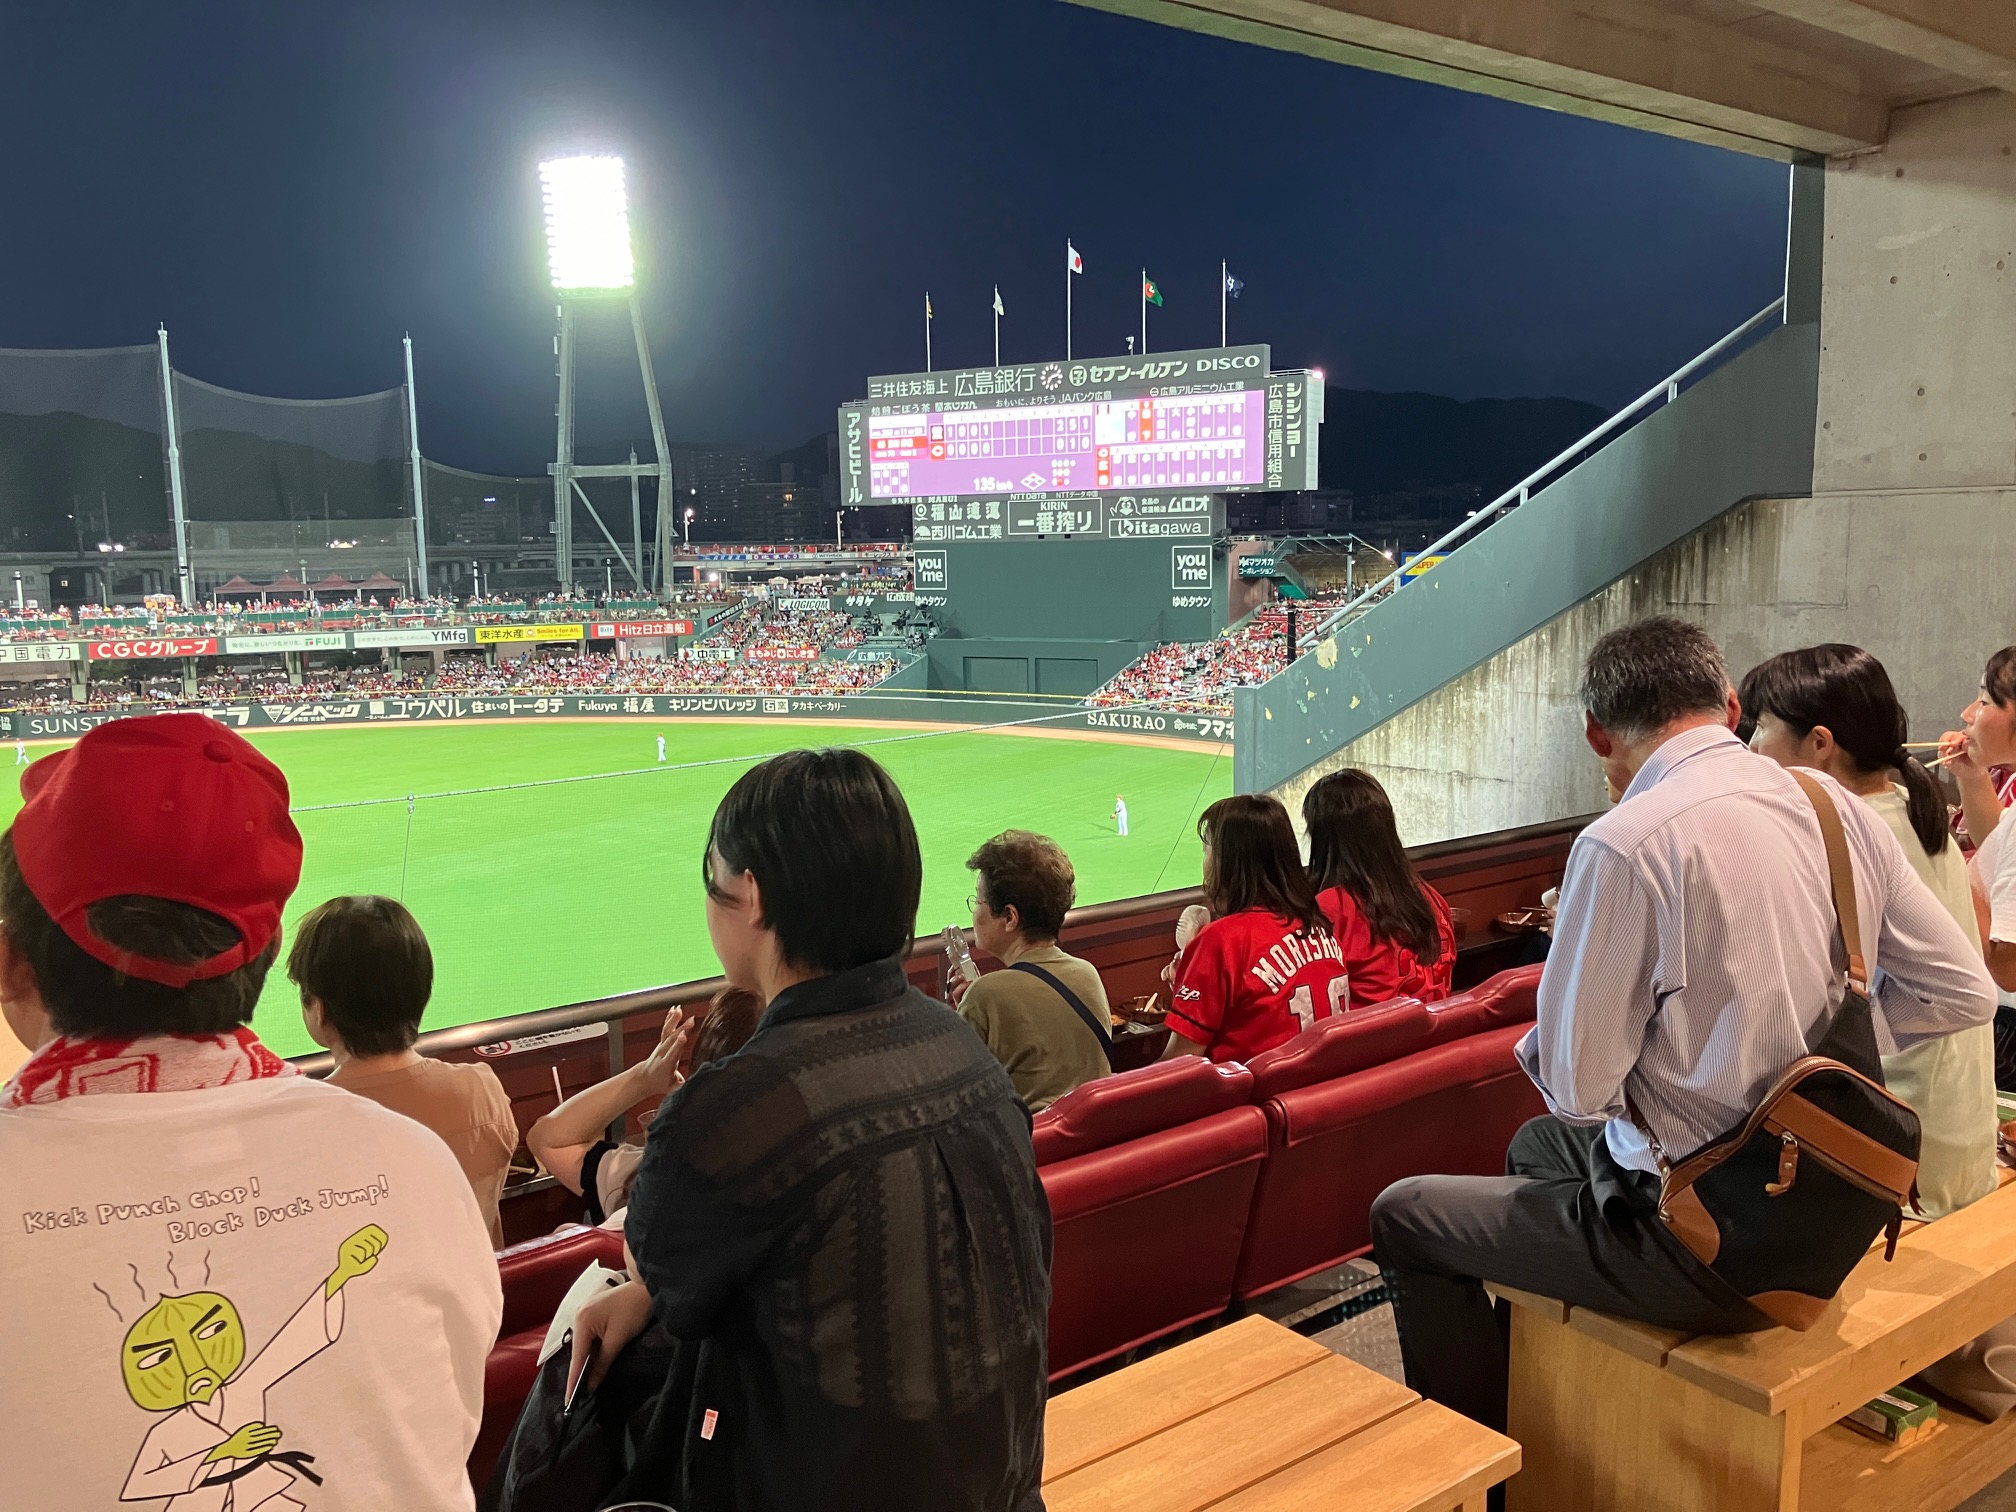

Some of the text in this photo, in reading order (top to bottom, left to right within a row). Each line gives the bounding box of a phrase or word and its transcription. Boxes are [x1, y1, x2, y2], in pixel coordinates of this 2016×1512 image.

[1196, 355, 1260, 372] DISCO
[871, 379, 948, 398] 三井住友海上
[954, 368, 1036, 397] 広島銀行
[1160, 381, 1244, 396] 広島アルミニウム工業
[1059, 390, 1112, 404] JAバンク広島
[871, 402, 931, 416] 焙煎ごぼう茶
[948, 418, 1088, 438] 1 0 0 1 2 5 1
[1267, 383, 1284, 488] 広島市信用組合
[947, 436, 1089, 455] 0 0 0 0 0 1 0
[847, 412, 862, 503] アサヒビール
[974, 477, 995, 491] 135
[1010, 492, 1025, 500] NTT
[1040, 501, 1068, 510] KIRIN
[1168, 495, 1210, 512] ムロオ
[1018, 510, 1092, 532] 一番搾り
[931, 524, 1002, 540] 西川ゴム工業
[918, 558, 942, 572] you
[1177, 554, 1206, 570] you
[1248, 558, 1274, 566] マツオカ
[922, 570, 944, 582] me
[1182, 568, 1208, 580] me
[789, 600, 828, 610] LOGICOM
[846, 596, 874, 607] サタケ
[914, 596, 947, 606] ゆめタウン
[1172, 596, 1211, 608] ゆめタウン
[431, 631, 466, 642] YMfg
[480, 628, 524, 640] 東洋水産
[620, 623, 686, 636] Hitz日立造船
[98, 639, 210, 657] CGCグループ
[316, 637, 341, 646] FUJI
[748, 650, 815, 659] 生もみじ にしき堂
[858, 652, 893, 662] 広島ガス
[390, 699, 466, 719] ユウベル
[472, 698, 565, 714] 住まいの トータテ
[578, 697, 656, 714] Fukuya 福屋
[669, 698, 756, 712] キリンビバレッジ
[792, 702, 847, 712] タカキベーカリー
[279, 704, 361, 722] ジーベック
[31, 715, 132, 734] SUNSTA
[1088, 712, 1166, 730] SAKURAO
[22, 1176, 261, 1234] Kick Punch Chop!
[166, 1174, 390, 1244] Block Duck Jump!
